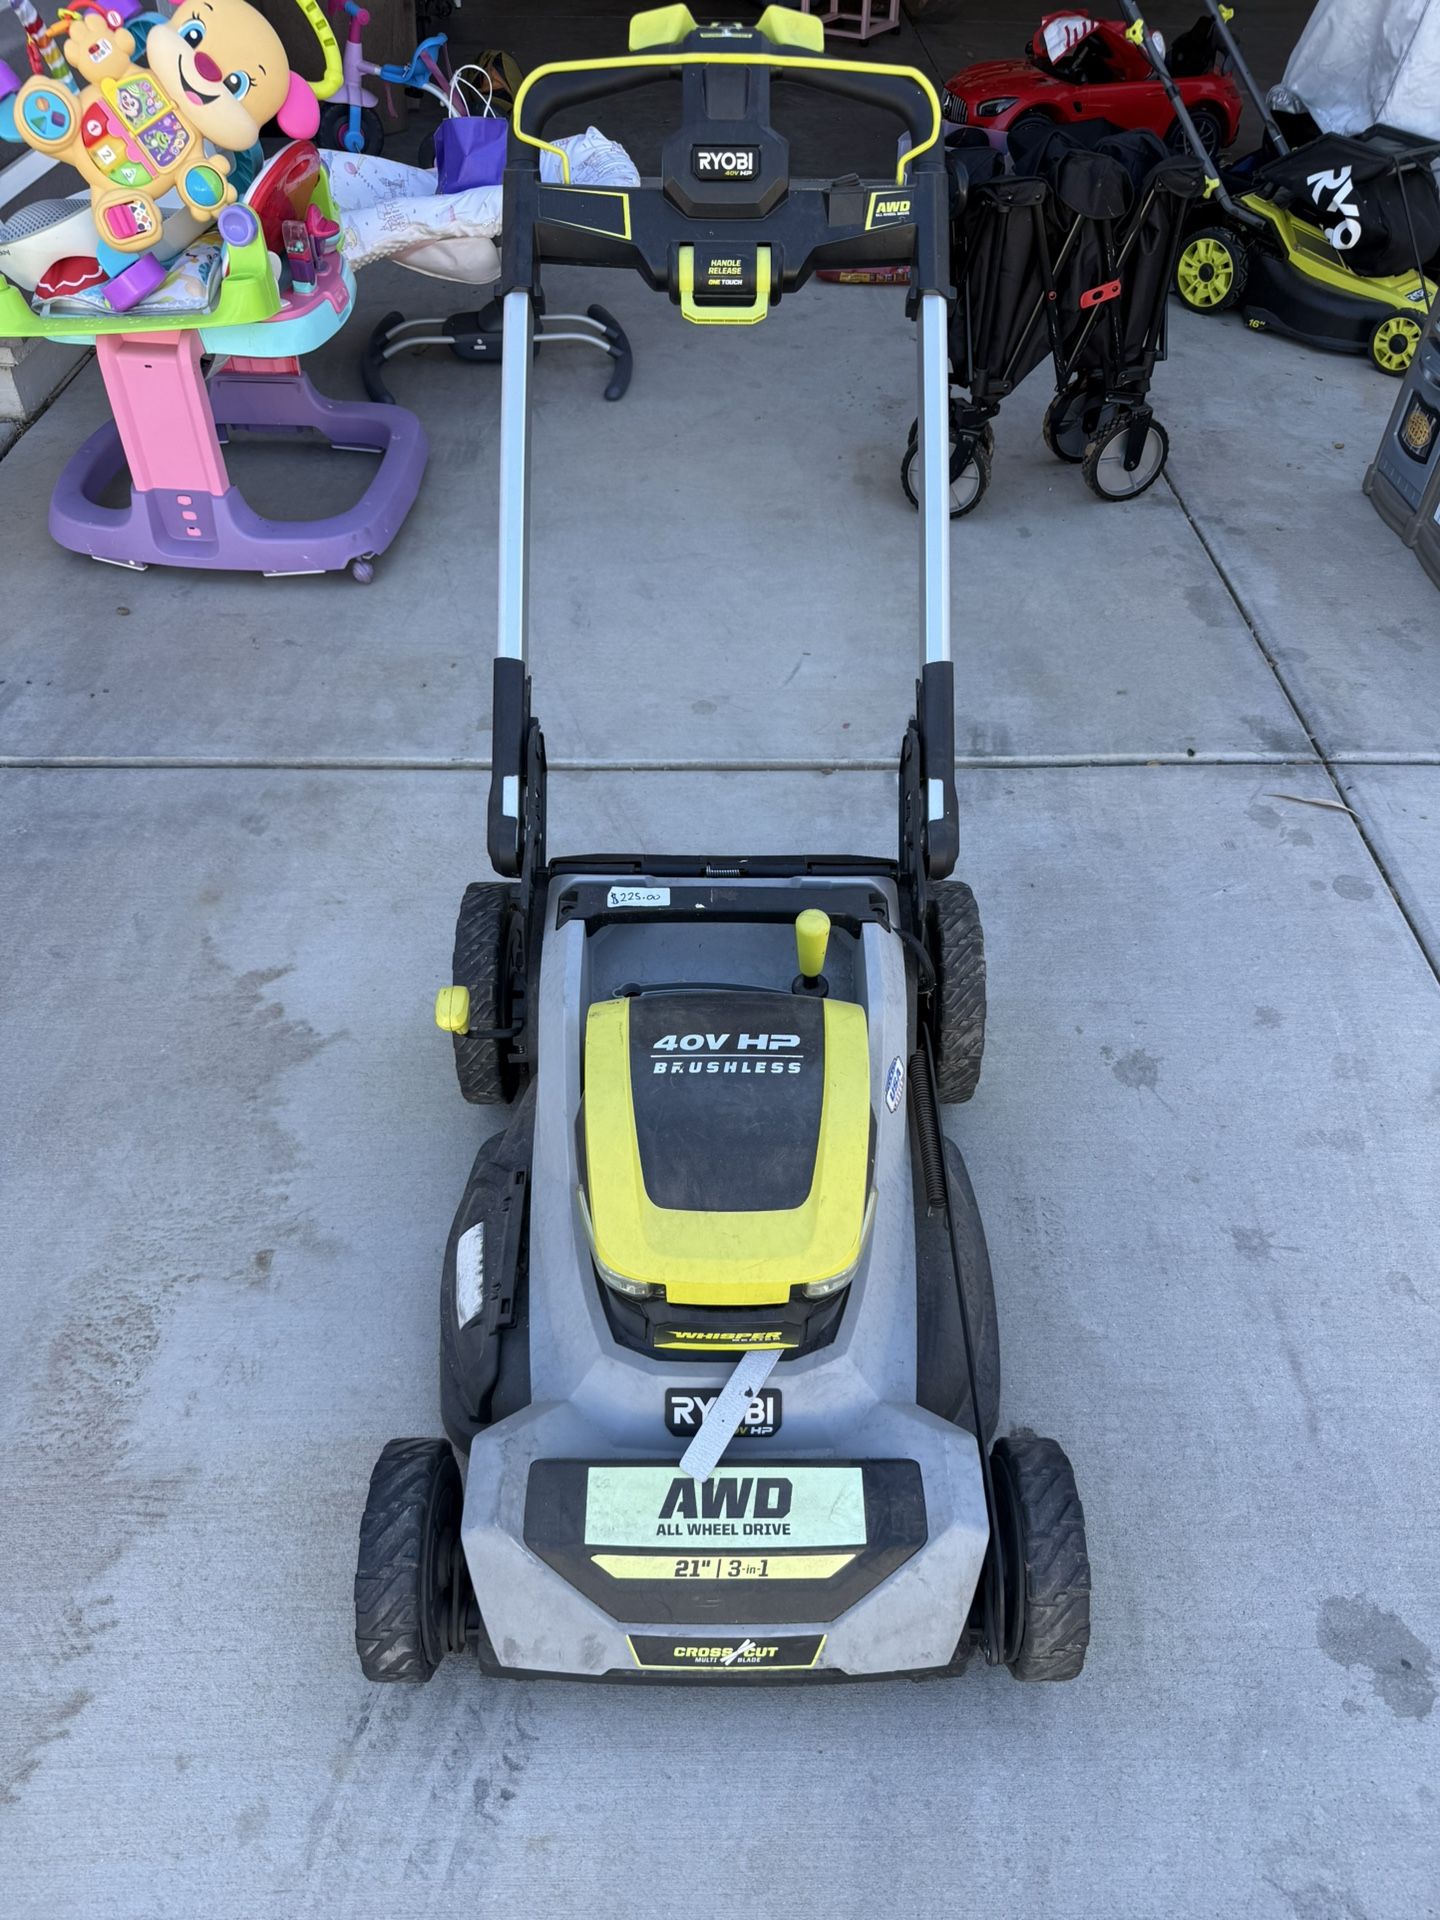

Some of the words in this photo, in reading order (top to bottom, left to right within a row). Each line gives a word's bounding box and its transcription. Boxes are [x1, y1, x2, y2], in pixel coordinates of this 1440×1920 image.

[698, 152, 753, 170] RYOBI
[876, 201, 910, 213] AWD
[1307, 165, 1362, 250] RYO
[708, 267, 742, 275] RELEASE
[611, 892, 661, 904] $225.00
[653, 1034, 730, 1051] 40V
[737, 1034, 801, 1050] HP
[653, 1061, 801, 1074] BRUSHLESS
[666, 1331, 782, 1340] WHISPER
[671, 1396, 774, 1425] RYBI
[658, 1477, 793, 1519] AWD
[656, 1523, 683, 1536] ALL
[687, 1523, 739, 1536] WHEEL
[743, 1523, 791, 1536] DRIVE
[674, 1559, 711, 1577] 21"
[673, 1647, 734, 1657] CROSS
[743, 1647, 779, 1657] CUT
